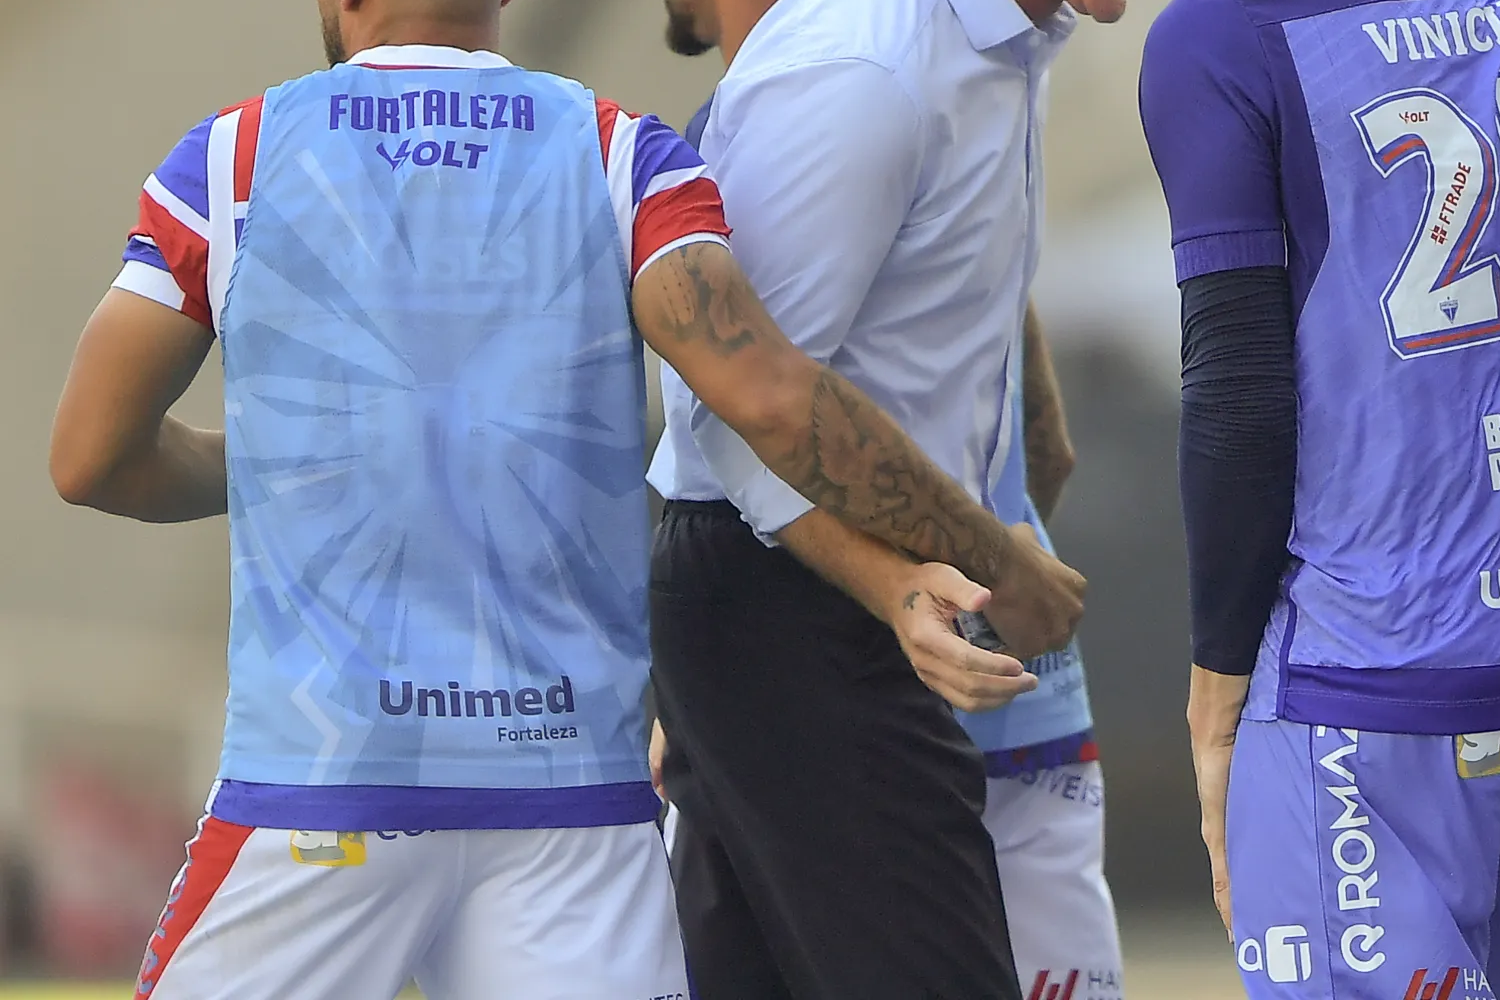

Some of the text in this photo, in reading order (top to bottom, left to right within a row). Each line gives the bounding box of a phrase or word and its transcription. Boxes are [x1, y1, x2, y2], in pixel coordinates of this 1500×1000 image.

[329, 89, 535, 134] FORTALEZA
[1399, 111, 1430, 124] VOLT
[375, 137, 489, 172] VOLT
[1438, 162, 1471, 225] FTRADE
[379, 675, 575, 717] Unimed
[496, 725, 578, 742] Fortaleza
